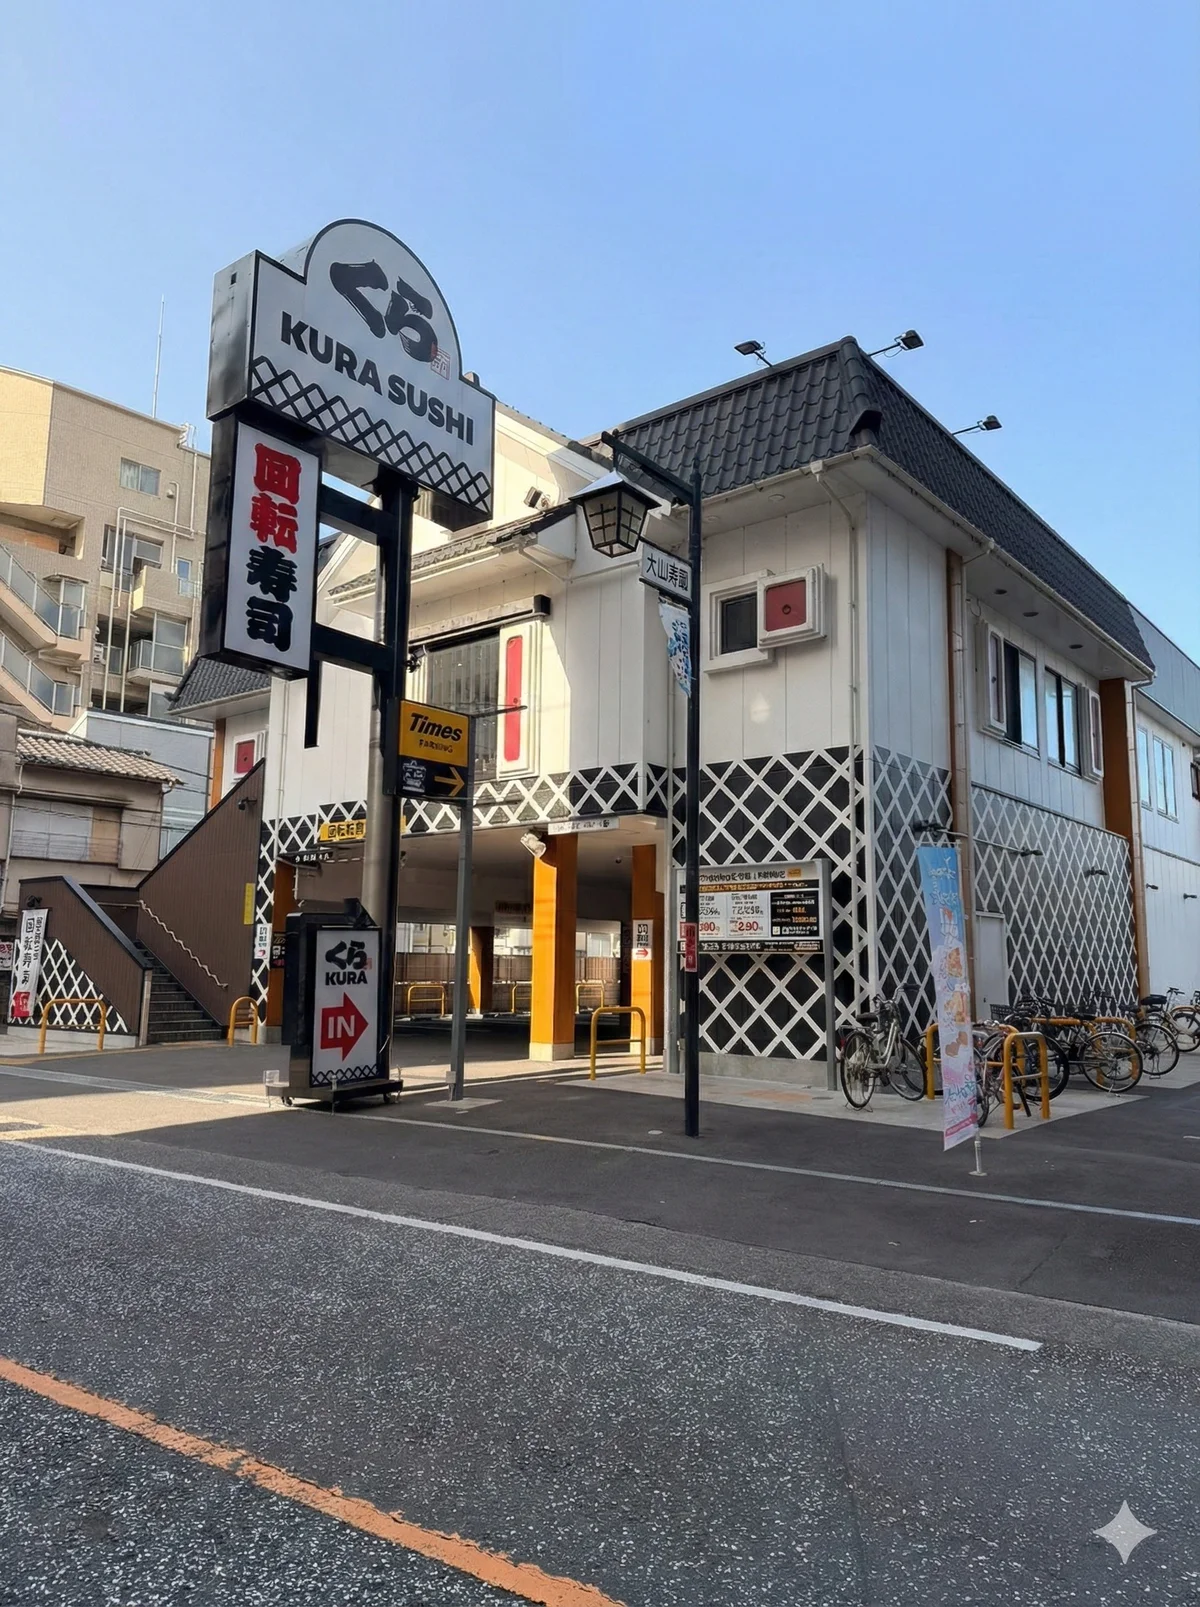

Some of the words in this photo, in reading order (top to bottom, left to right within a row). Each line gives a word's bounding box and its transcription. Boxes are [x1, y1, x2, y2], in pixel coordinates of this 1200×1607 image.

[329, 259, 438, 363] くら
[280, 311, 383, 396] KURA
[387, 374, 474, 446] SUSHI
[246, 443, 302, 652] 回転寿司
[410, 713, 462, 741] Times
[325, 939, 368, 971] くら
[325, 970, 368, 986] KURA
[327, 1014, 356, 1039] IN
